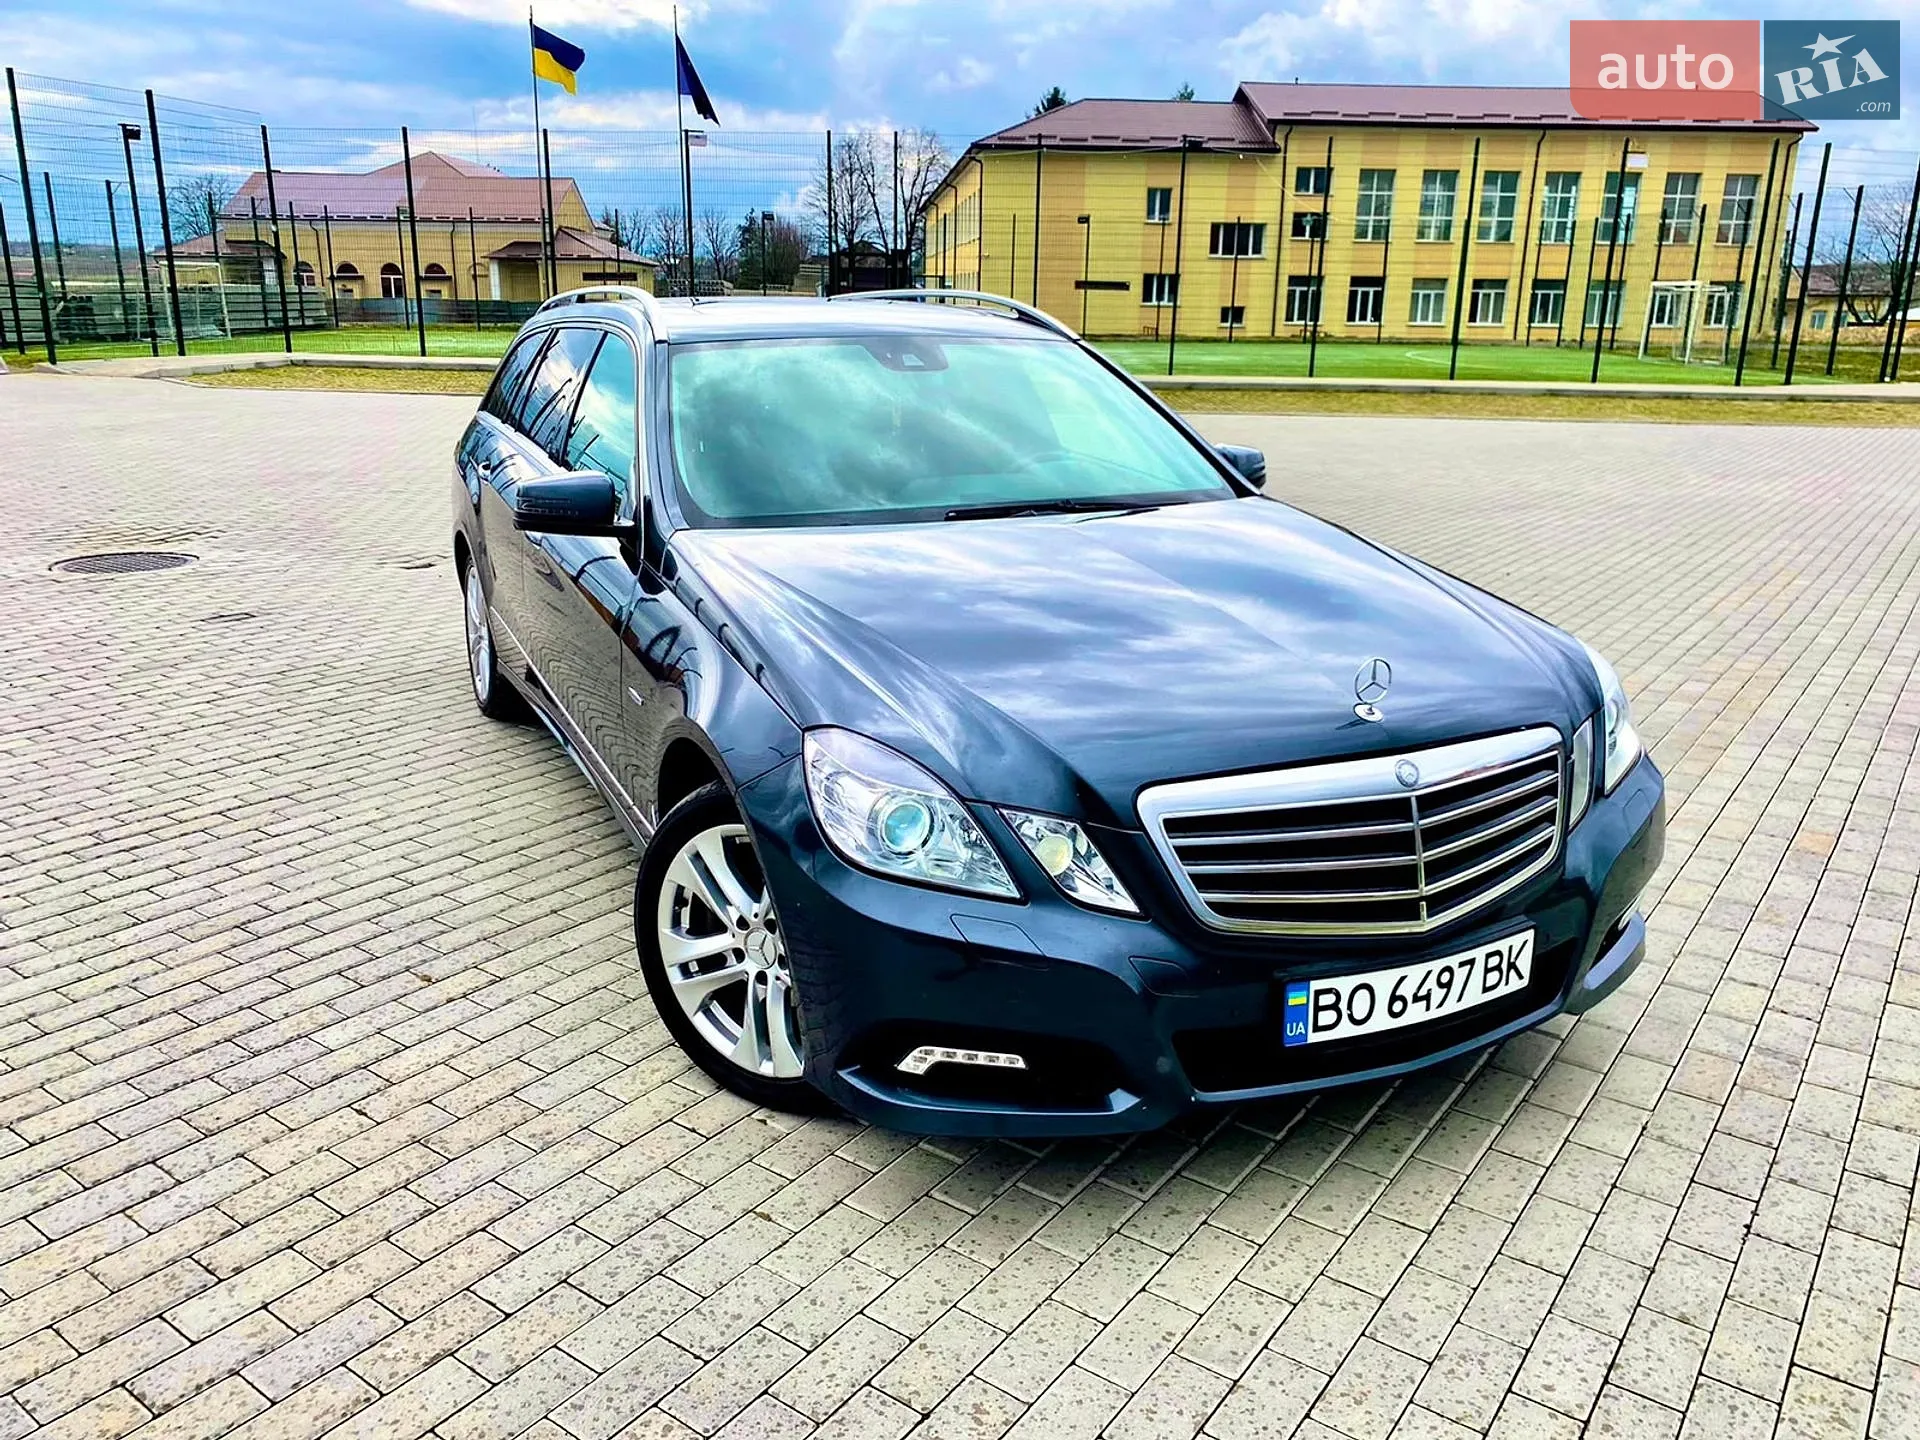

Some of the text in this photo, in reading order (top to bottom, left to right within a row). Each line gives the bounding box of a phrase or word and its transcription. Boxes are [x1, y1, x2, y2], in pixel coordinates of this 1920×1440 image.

[1311, 938, 1529, 1033] BO 6497 BK
[1286, 1022, 1305, 1036] UA
